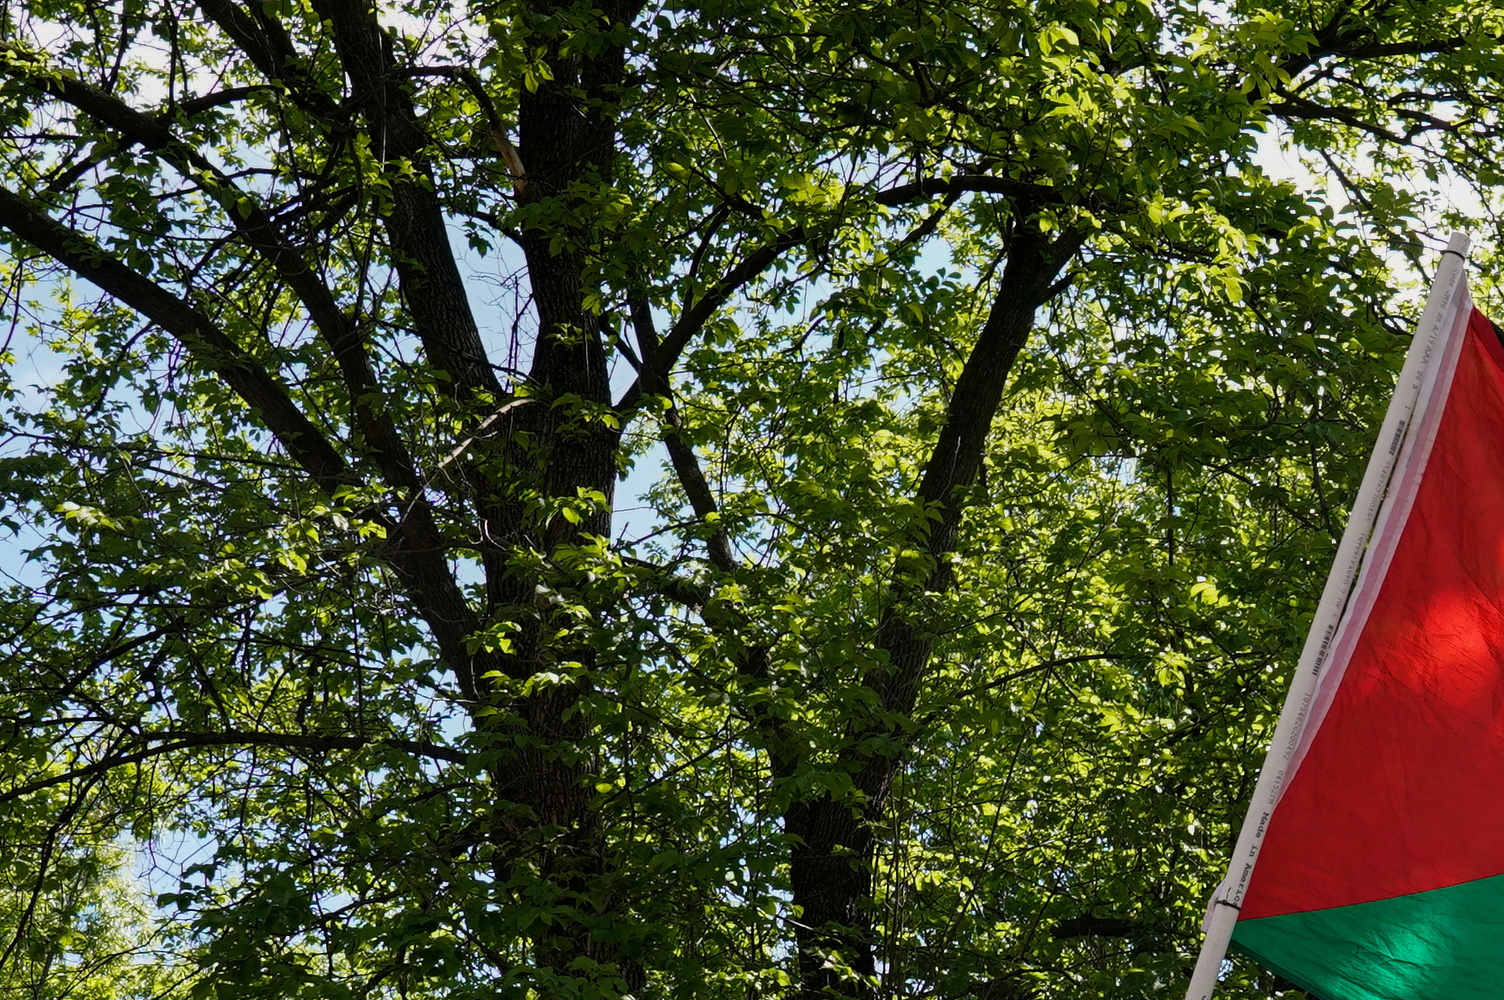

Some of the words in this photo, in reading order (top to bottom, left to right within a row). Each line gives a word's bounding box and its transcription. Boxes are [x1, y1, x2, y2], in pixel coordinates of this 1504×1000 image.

[1447, 267, 1460, 288] Code
[1254, 810, 1270, 839] Made
[1248, 843, 1259, 858] in
[1231, 862, 1252, 908] America
